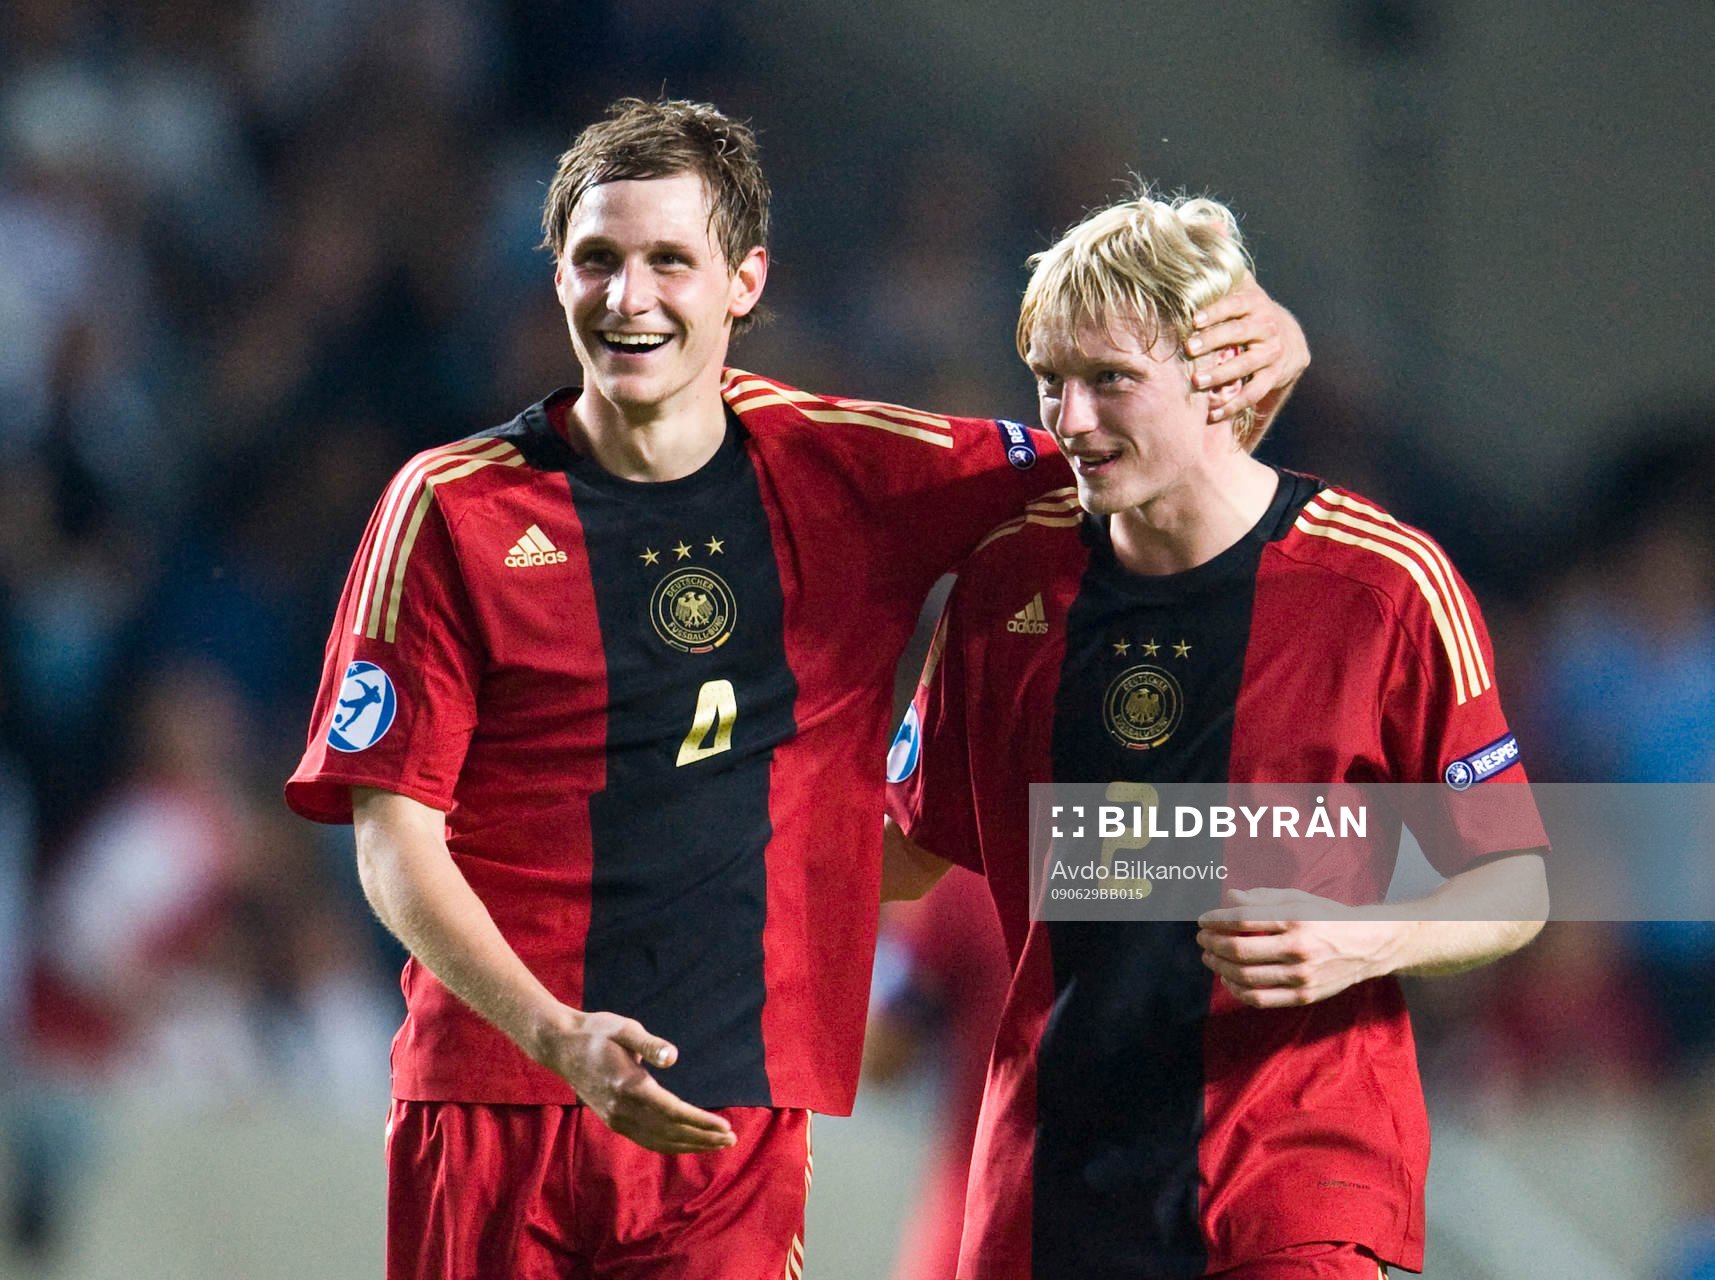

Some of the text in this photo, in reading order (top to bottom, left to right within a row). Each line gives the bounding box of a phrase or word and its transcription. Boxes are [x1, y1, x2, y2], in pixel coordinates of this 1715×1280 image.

[504, 550, 568, 568] adidas
[666, 577, 714, 598] DEUTSCHER
[1007, 619, 1049, 634] adidas
[676, 679, 738, 767] 4
[1098, 781, 1160, 898] 2
